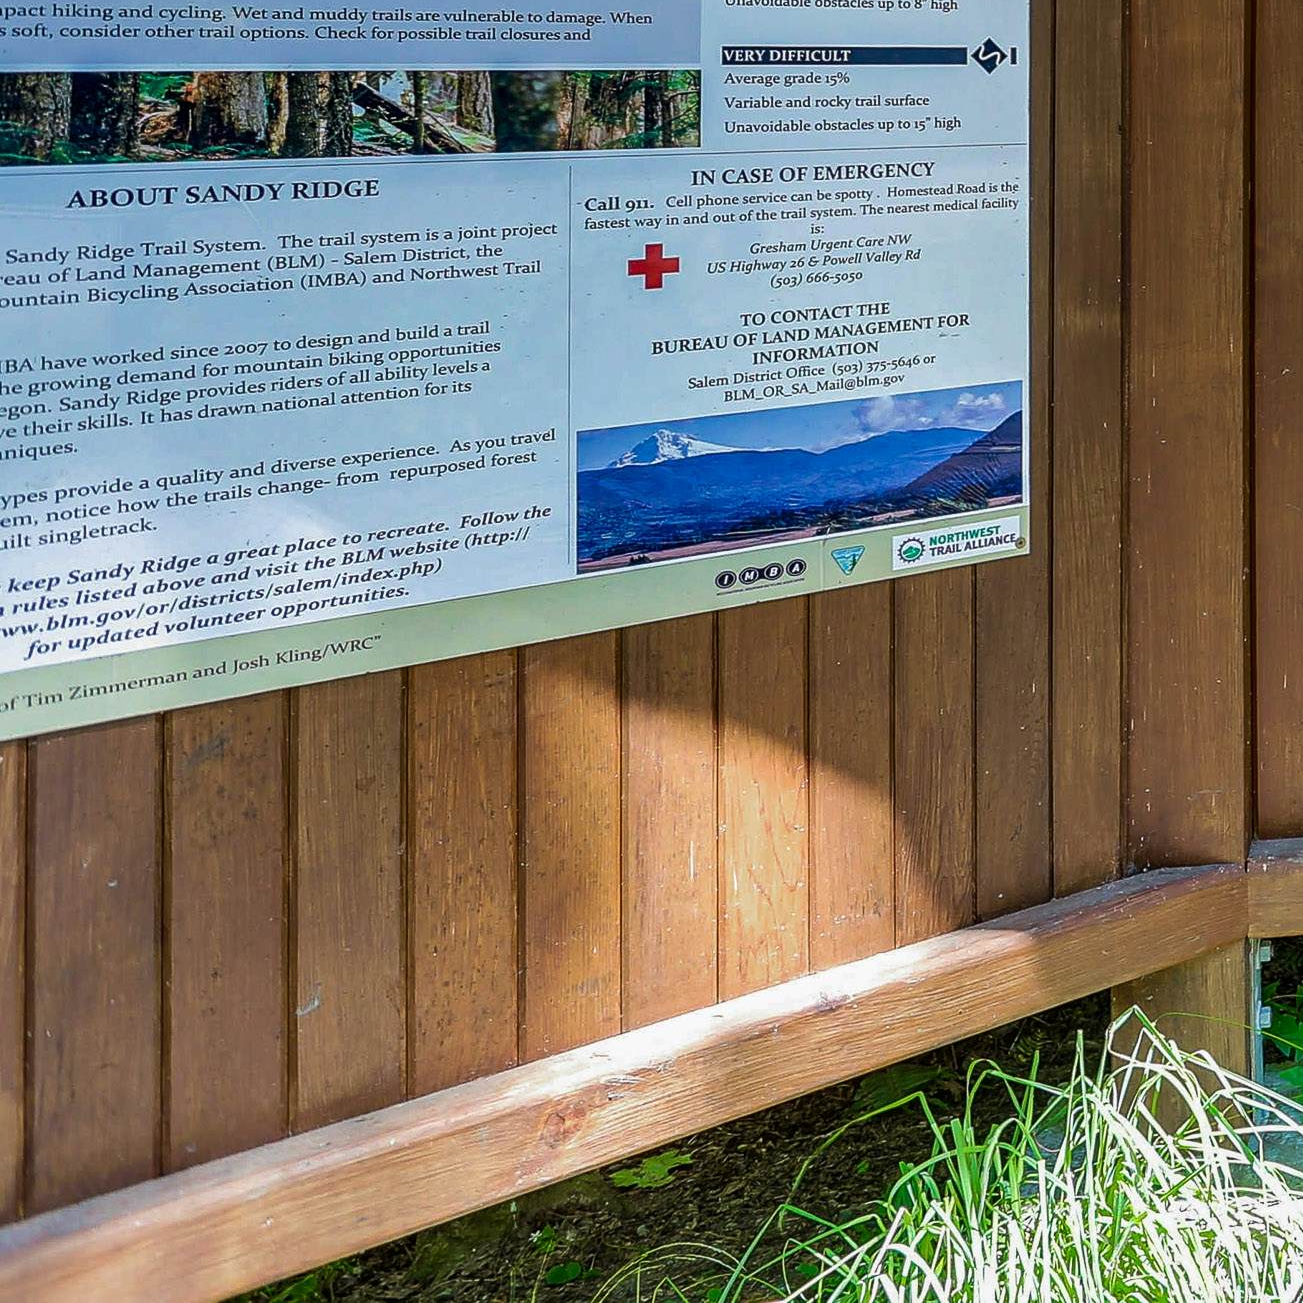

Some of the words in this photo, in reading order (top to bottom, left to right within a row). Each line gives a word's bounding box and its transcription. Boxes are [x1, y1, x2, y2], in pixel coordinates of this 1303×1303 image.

[723, 49, 766, 62] VERY
[769, 49, 851, 62] DIFFICULT
[690, 169, 716, 186] IN
[721, 167, 774, 184] CASE
[779, 166, 808, 182] OF
[812, 161, 935, 181] EMERGENCY
[66, 183, 179, 209] ABOUT
[183, 181, 289, 207] SANDY
[290, 176, 380, 200] RIDGE
[583, 196, 621, 213] Call
[625, 196, 655, 213] 911.
[770, 272, 803, 289] (503)
[804, 271, 863, 285] 666-5050
[651, 335, 729, 355] BUREAU
[733, 332, 758, 347] OF
[762, 328, 810, 344] LAND
[814, 316, 934, 339] MANAGEMENT
[937, 313, 970, 328] FOR
[752, 340, 879, 365] INFORMATION
[928, 540, 962, 557] TRAIL
[963, 532, 1017, 551] ALLIANCE
[929, 525, 1002, 549] NORTHWEST
